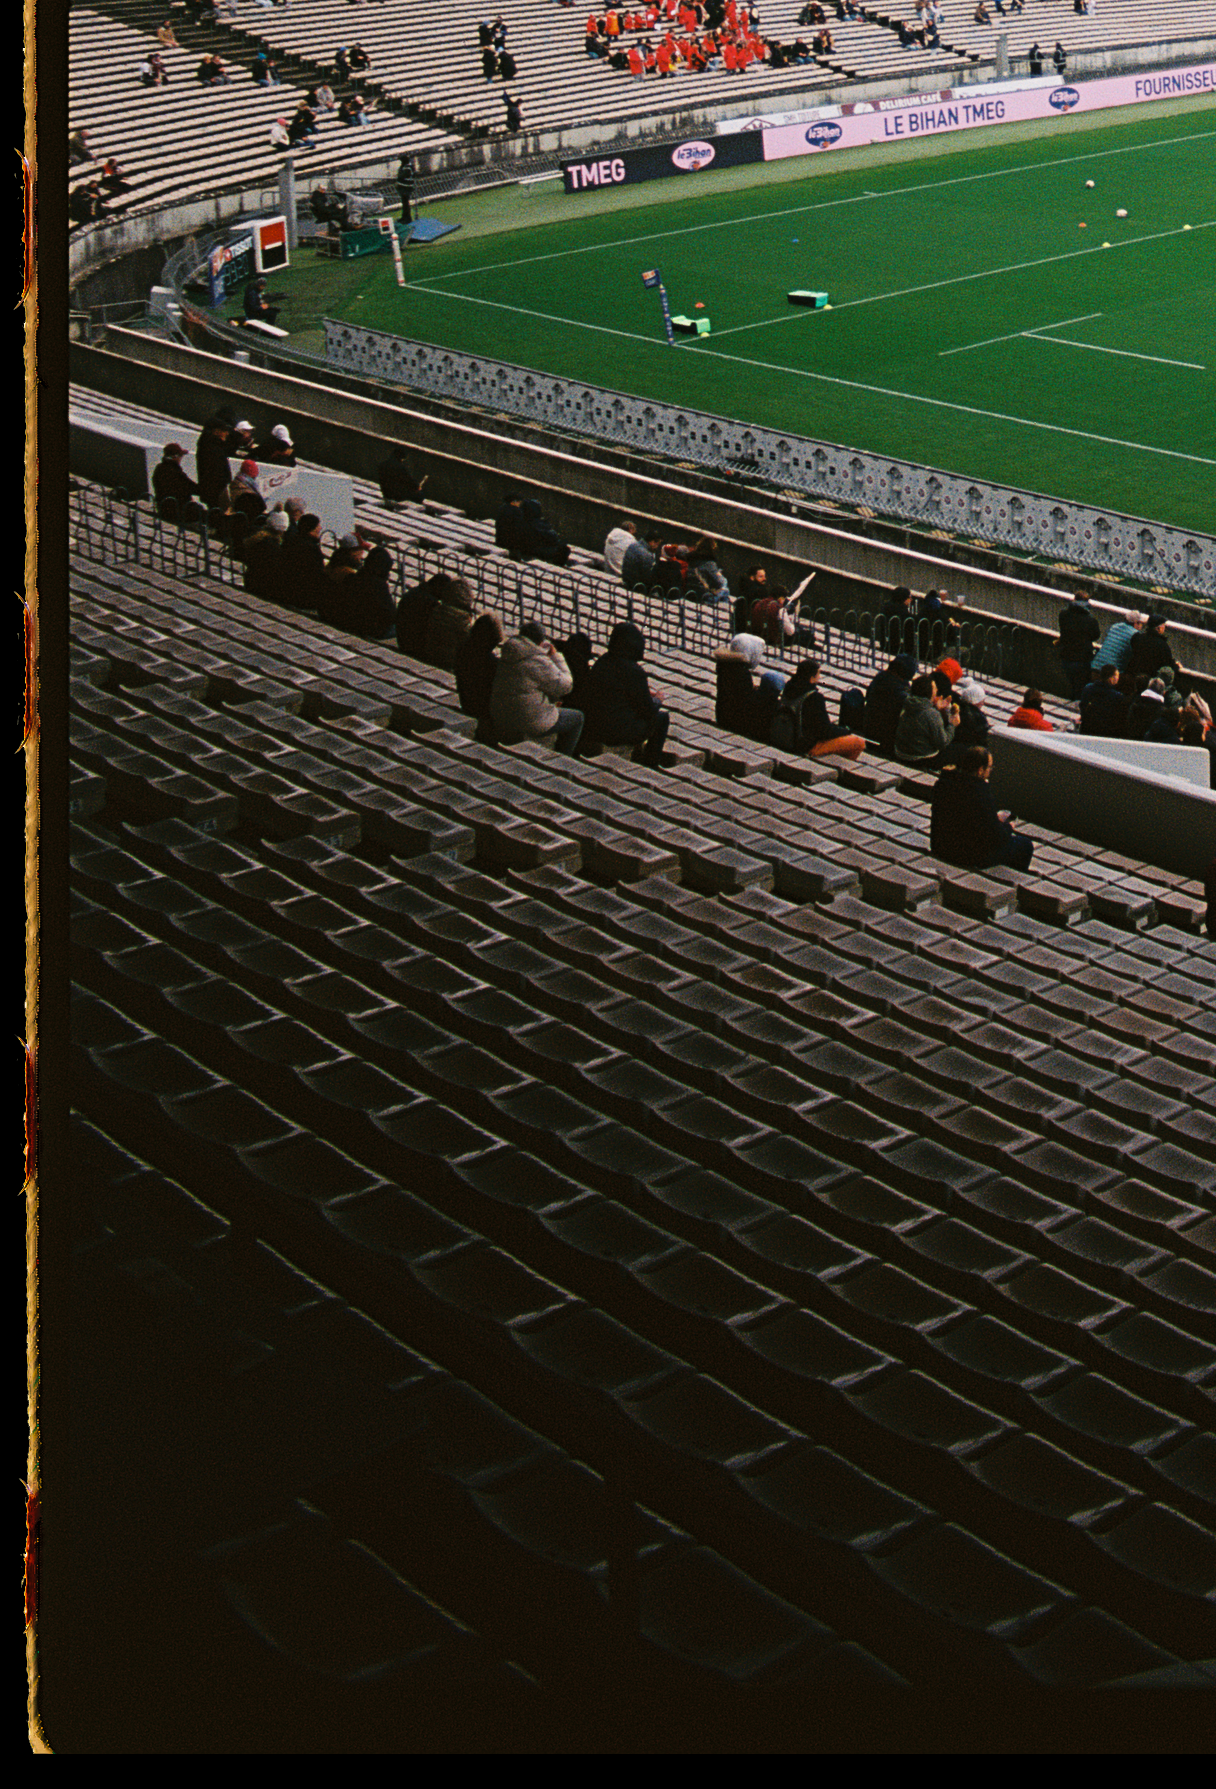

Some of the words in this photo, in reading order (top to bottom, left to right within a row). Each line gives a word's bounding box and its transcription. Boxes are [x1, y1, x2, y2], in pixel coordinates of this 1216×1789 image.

[884, 115, 904, 136] LE
[909, 106, 959, 132] BIHAN
[963, 100, 1005, 123] TMEG
[567, 158, 626, 188] TMEG
